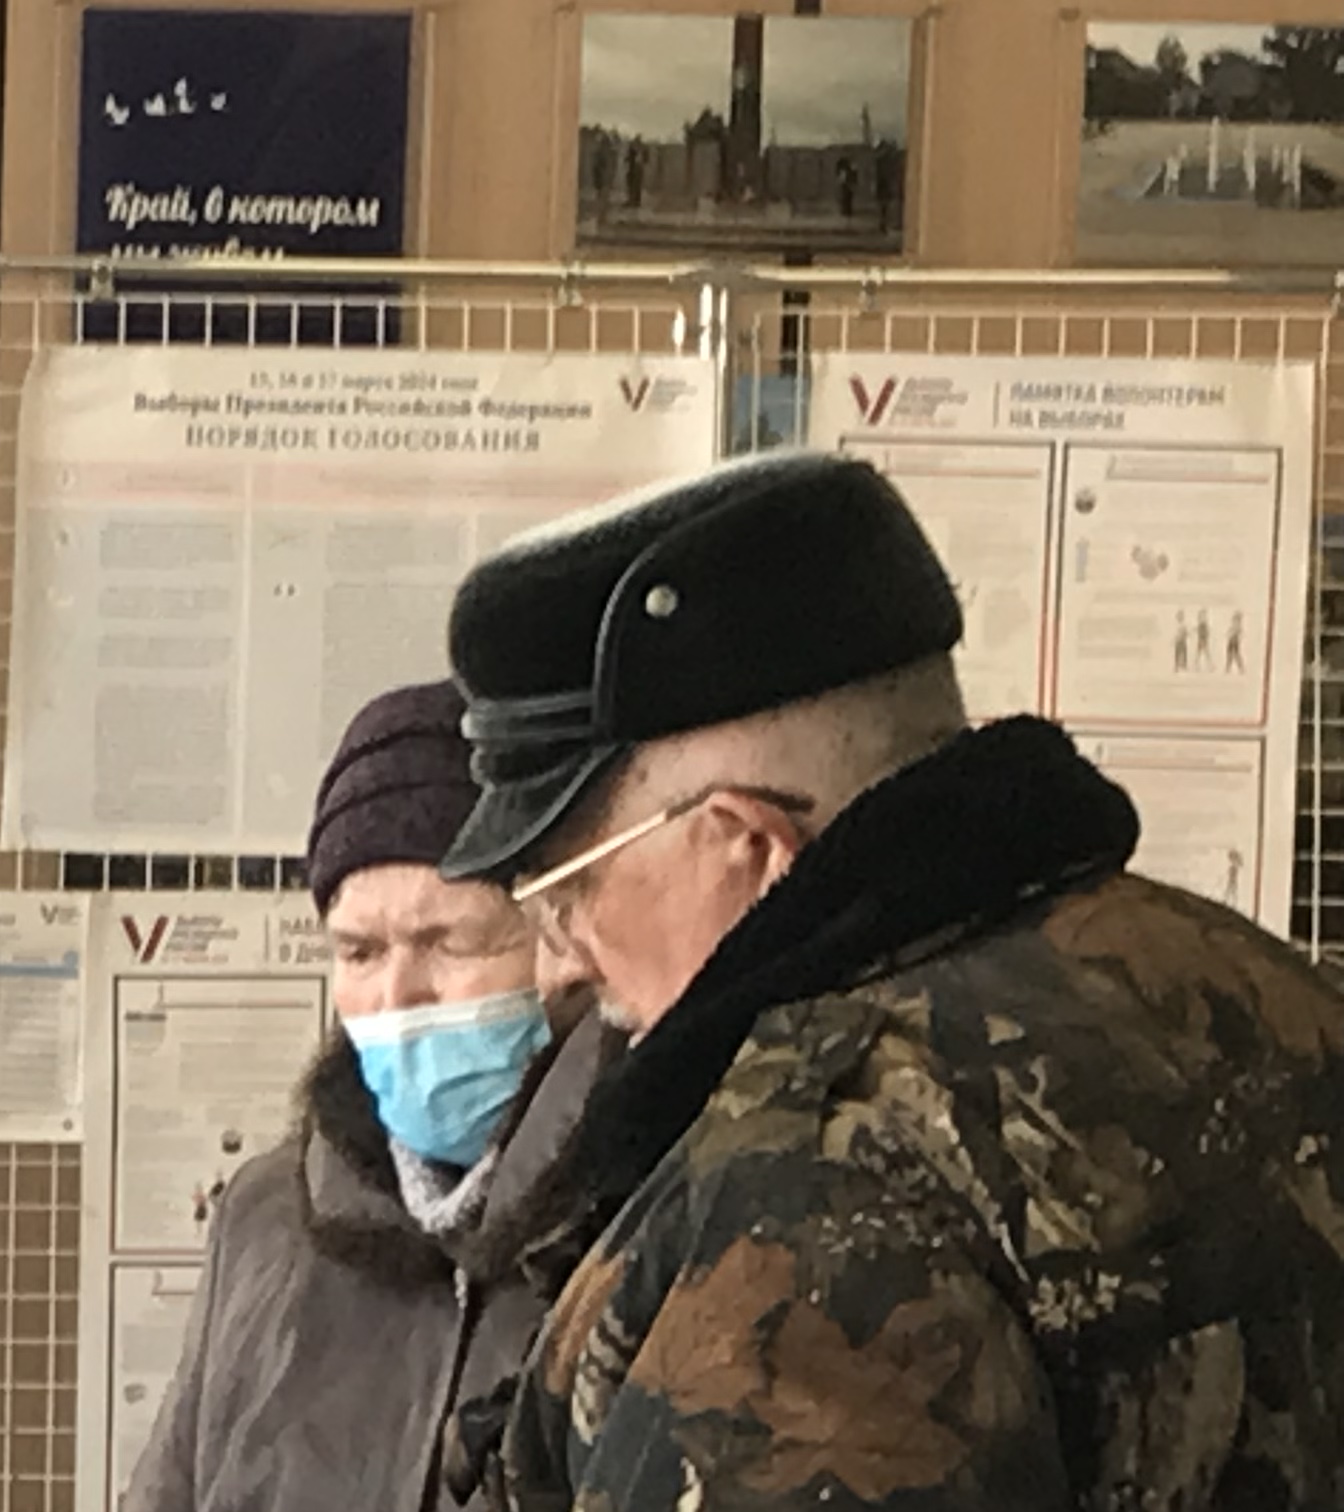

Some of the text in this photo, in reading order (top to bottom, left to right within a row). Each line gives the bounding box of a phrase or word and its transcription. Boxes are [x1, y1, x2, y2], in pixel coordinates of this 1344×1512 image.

[105, 181, 380, 234] Край, в котором
[134, 391, 592, 423] Выборы Президента Российской Федерации
[185, 425, 541, 451] ПОРЯДОК ГОЛОСОВАНИЯ
